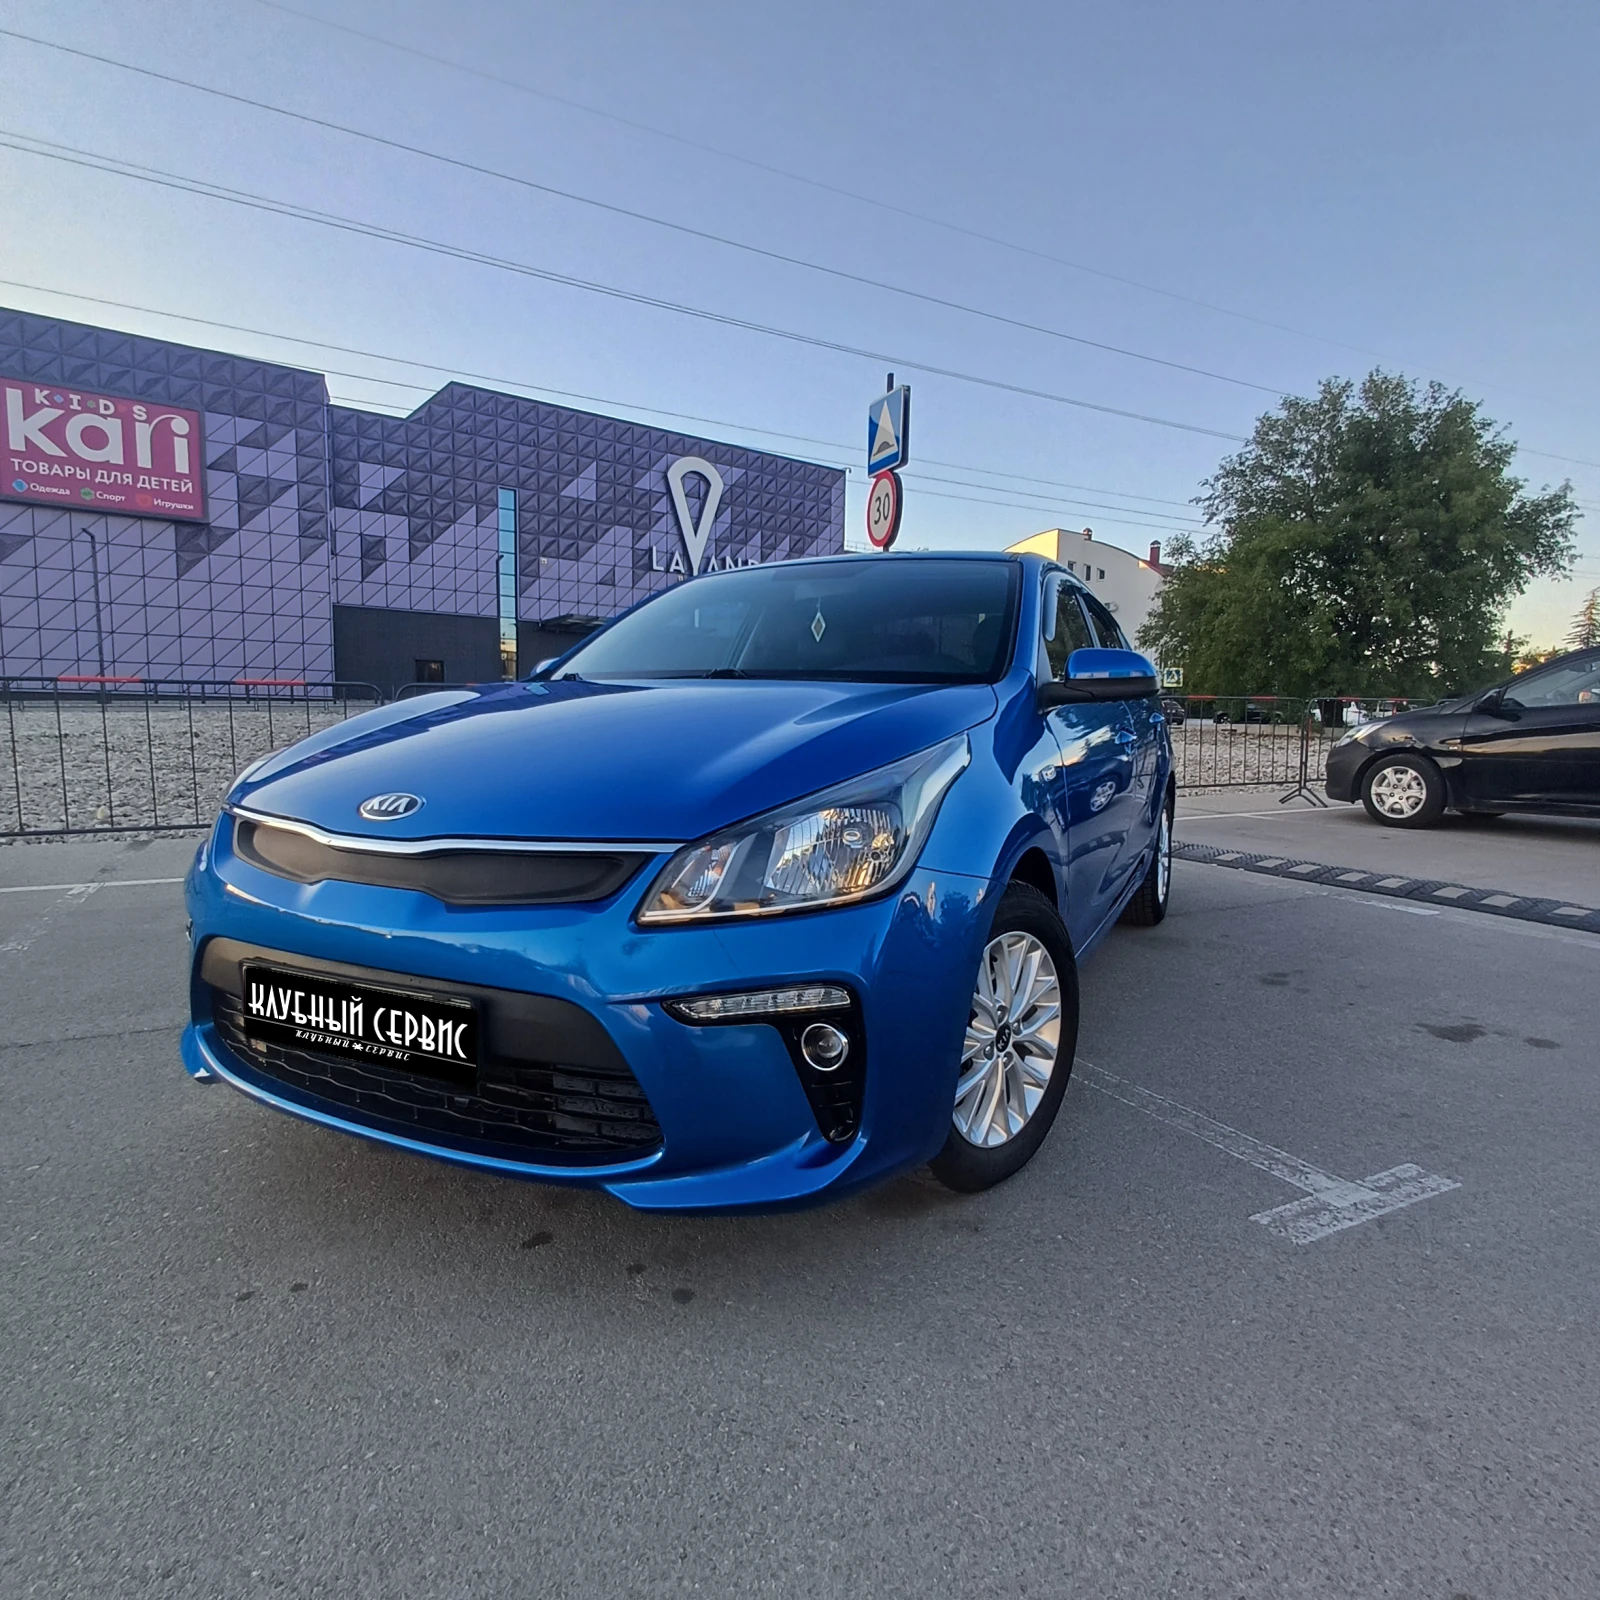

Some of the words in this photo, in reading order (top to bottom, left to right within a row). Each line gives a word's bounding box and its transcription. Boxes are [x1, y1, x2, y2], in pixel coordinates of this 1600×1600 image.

[34, 388, 149, 421] KIDS
[6, 387, 190, 475] kari
[10, 457, 91, 481] ТОВАРЫ
[95, 469, 133, 486] ДЛЯ
[137, 474, 194, 494] ДЕТЕЙ
[30, 482, 71, 496] Одежда
[96, 490, 126, 503] Спорт
[153, 497, 194, 511] Игрушки
[873, 492, 891, 526] 30
[366, 795, 411, 813] KIA
[997, 1028, 1010, 1050] KIA
